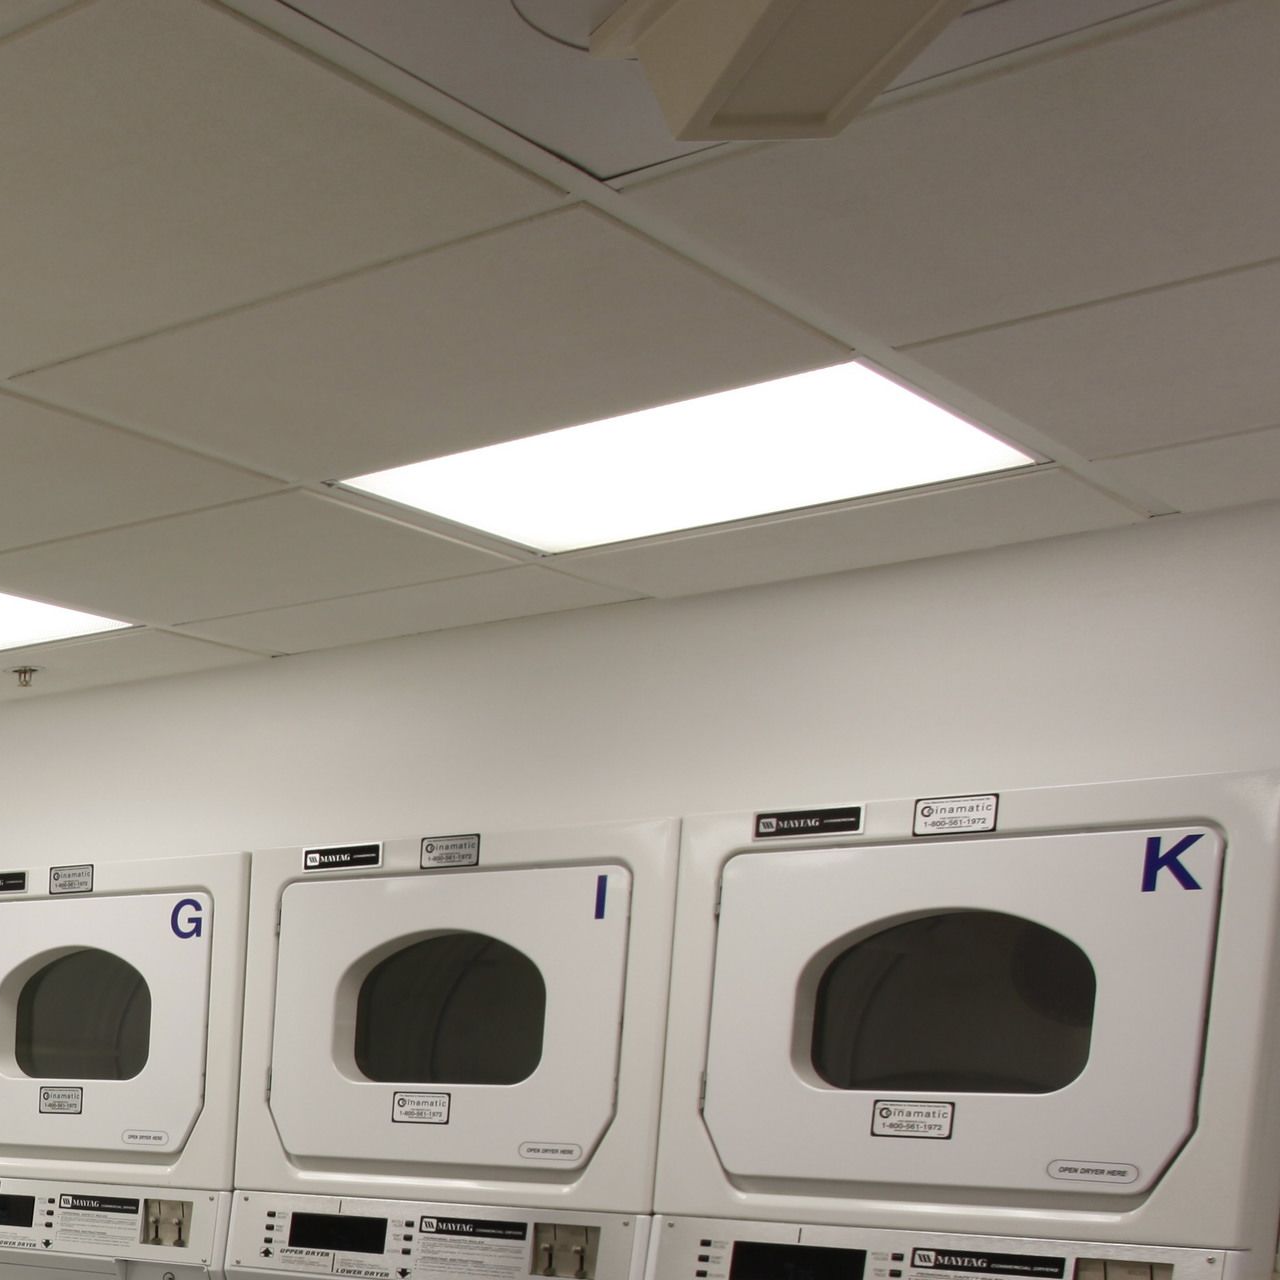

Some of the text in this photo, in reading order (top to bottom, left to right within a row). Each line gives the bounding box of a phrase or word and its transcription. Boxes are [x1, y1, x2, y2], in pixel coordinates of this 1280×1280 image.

[778, 818, 820, 829] MAYTAG
[923, 817, 987, 828] 1-800-561-1972
[1141, 834, 1205, 893] K
[594, 875, 608, 919] I
[170, 898, 203, 939] G
[882, 1122, 943, 1131] 1-800-561-1972
[1058, 1166, 1128, 1178] OPEN DRYER HERE
[437, 1222, 474, 1232] MAYTAG
[936, 1254, 989, 1268] MAYTAG
